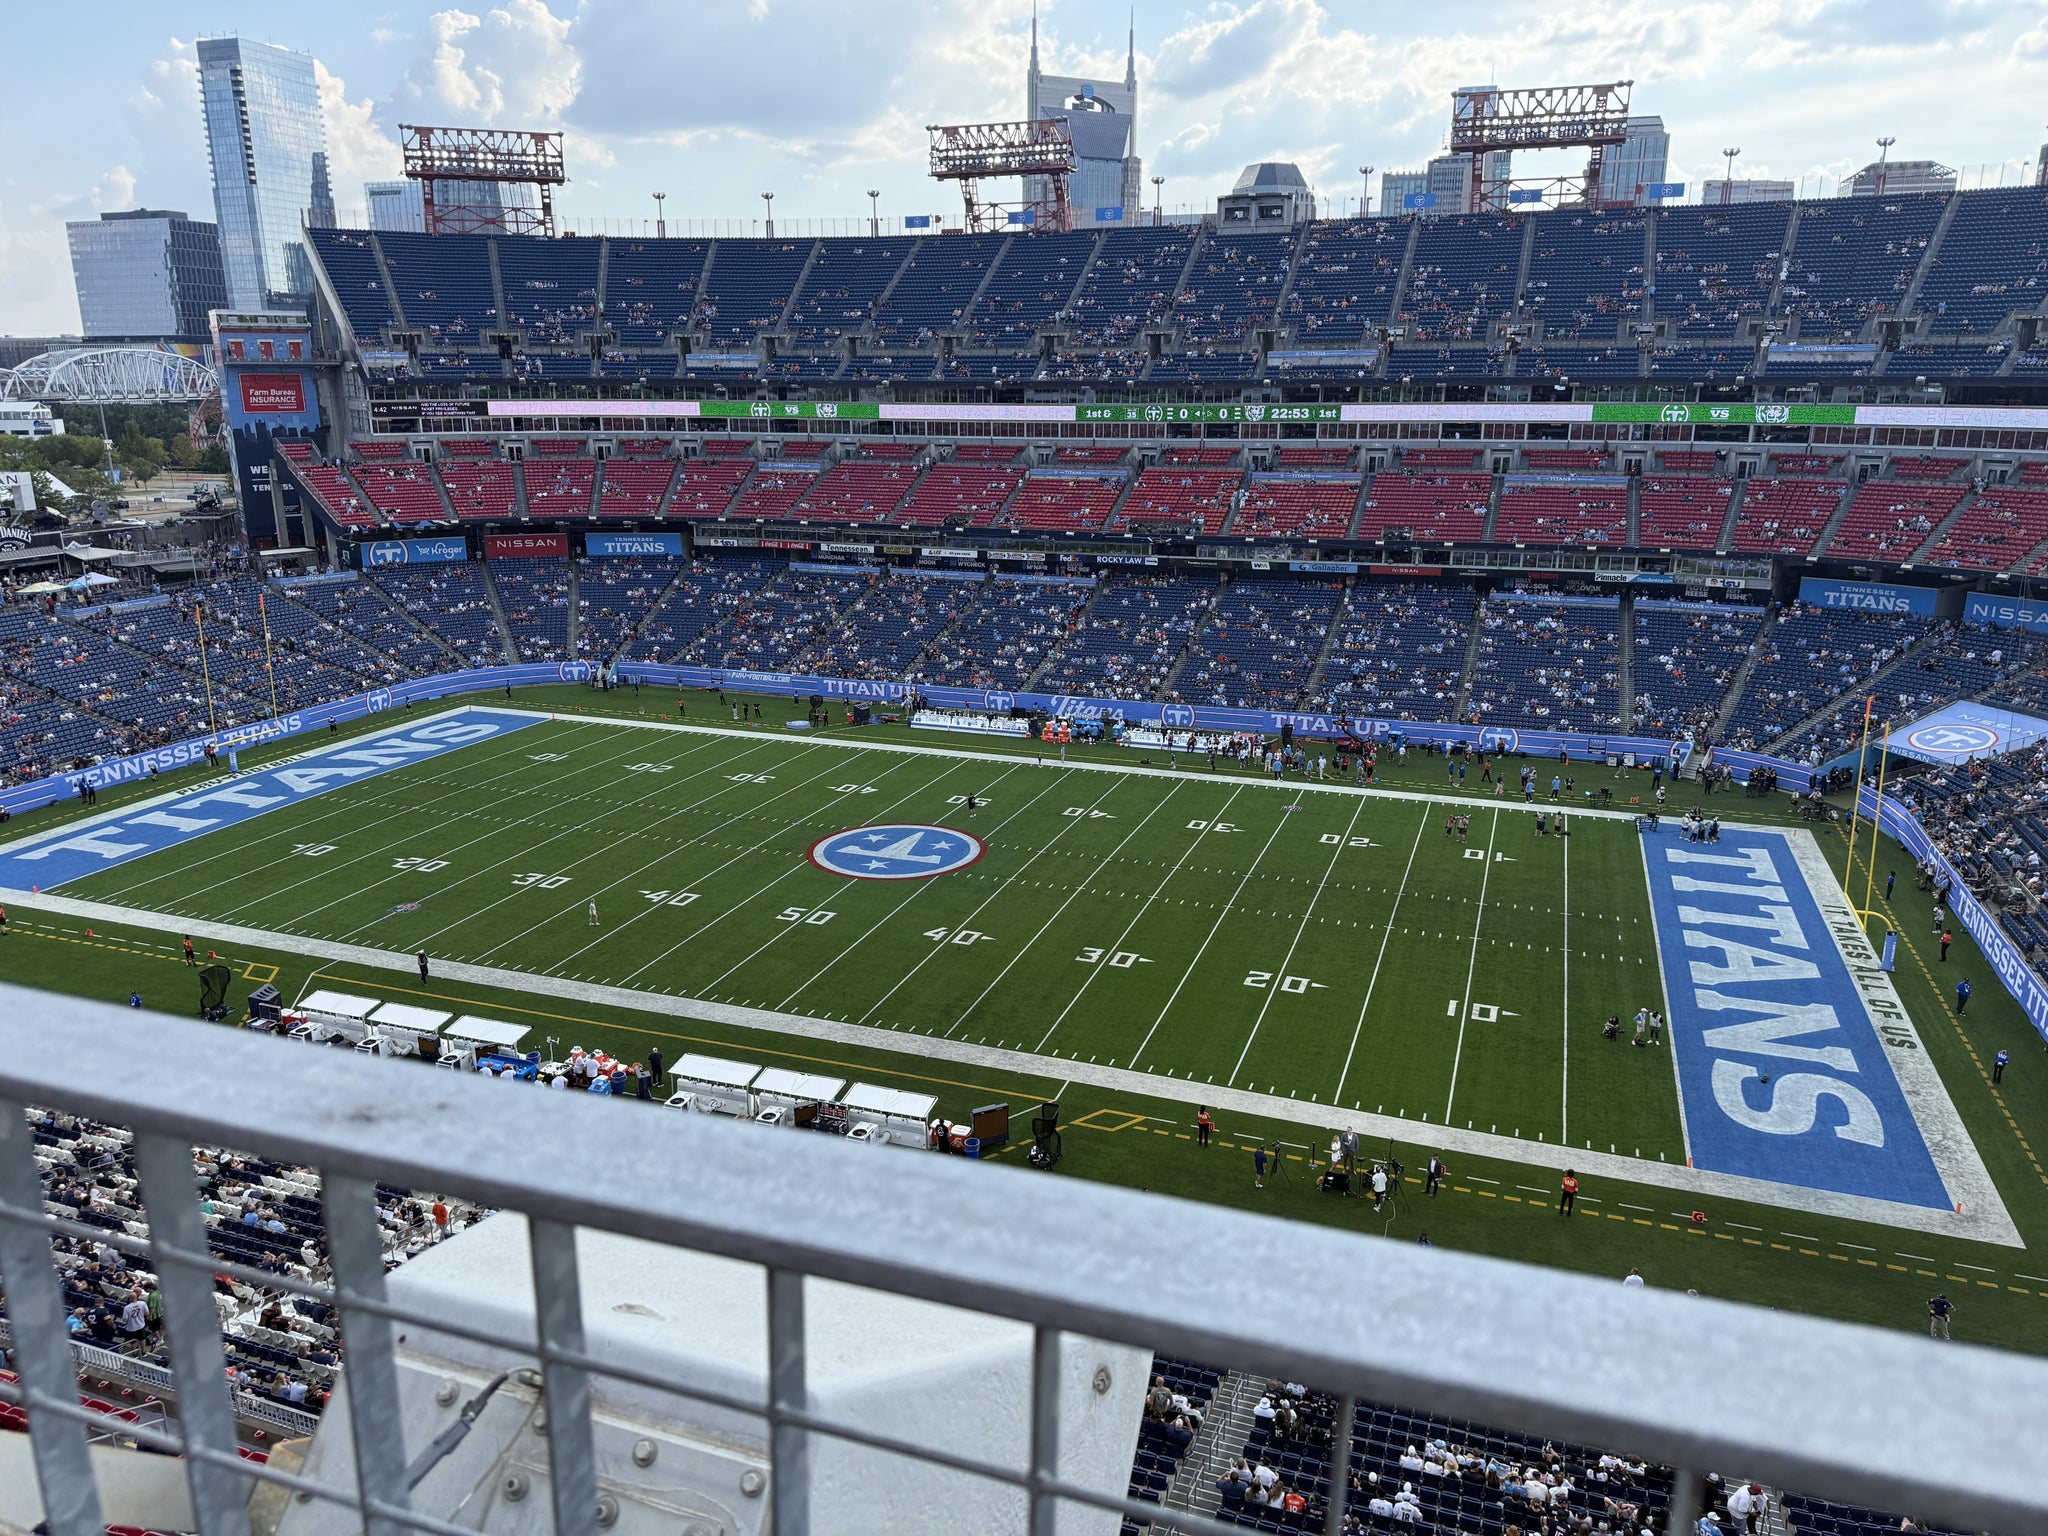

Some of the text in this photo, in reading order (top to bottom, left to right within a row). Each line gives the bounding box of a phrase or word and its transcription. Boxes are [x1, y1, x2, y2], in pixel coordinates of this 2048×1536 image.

[784, 407, 799, 415] VS
[1086, 409, 1112, 418] 1st &
[1126, 411, 1137, 419] 35
[1179, 408, 1188, 419] 0
[1219, 408, 1228, 419] 0
[1271, 408, 1309, 418] 22:53
[1319, 409, 1336, 418] 1st
[1710, 409, 1729, 418] VS
[250, 465, 269, 475] WE
[431, 542, 463, 559] Kroger
[496, 538, 557, 549] NISSAN
[604, 542, 665, 553] TITANS
[826, 543, 872, 552] Tennessean.
[1060, 554, 1079, 562] FedEx
[1096, 556, 1142, 564] ROCKY LAW
[1312, 564, 1348, 572] Gallagher
[1596, 574, 1627, 582] Pinnacle
[1840, 585, 1897, 596] TENNESSEE
[1824, 591, 1910, 612] TITANS
[823, 679, 885, 697] TITAN
[1354, 719, 1390, 736] UP
[1957, 714, 2036, 735] NISSAN
[65, 715, 302, 793] TENNESSEE TITANS
[1890, 746, 1930, 762] NISSAN
[629, 762, 675, 773] 20
[730, 773, 776, 784] 30
[12, 720, 500, 860] TITANS
[834, 783, 879, 794] 40
[1061, 806, 1108, 819] 40
[1185, 819, 1235, 833] 30
[1318, 833, 1370, 848] 20
[289, 843, 339, 857] 10
[1462, 848, 1503, 862] 10
[392, 857, 451, 872] 20
[511, 873, 573, 889] 30
[643, 890, 702, 906] 40
[775, 906, 838, 925] 50
[922, 926, 984, 946] 40
[1957, 889, 2027, 998] TENNESSEE
[1074, 946, 1140, 968] 30
[1242, 970, 1311, 994] 20
[1822, 903, 1918, 1051] IT TAKES ALL OF US
[1664, 847, 1885, 1149] TITANS
[1446, 999, 1500, 1023] 10
[1693, 1212, 1704, 1222] G
